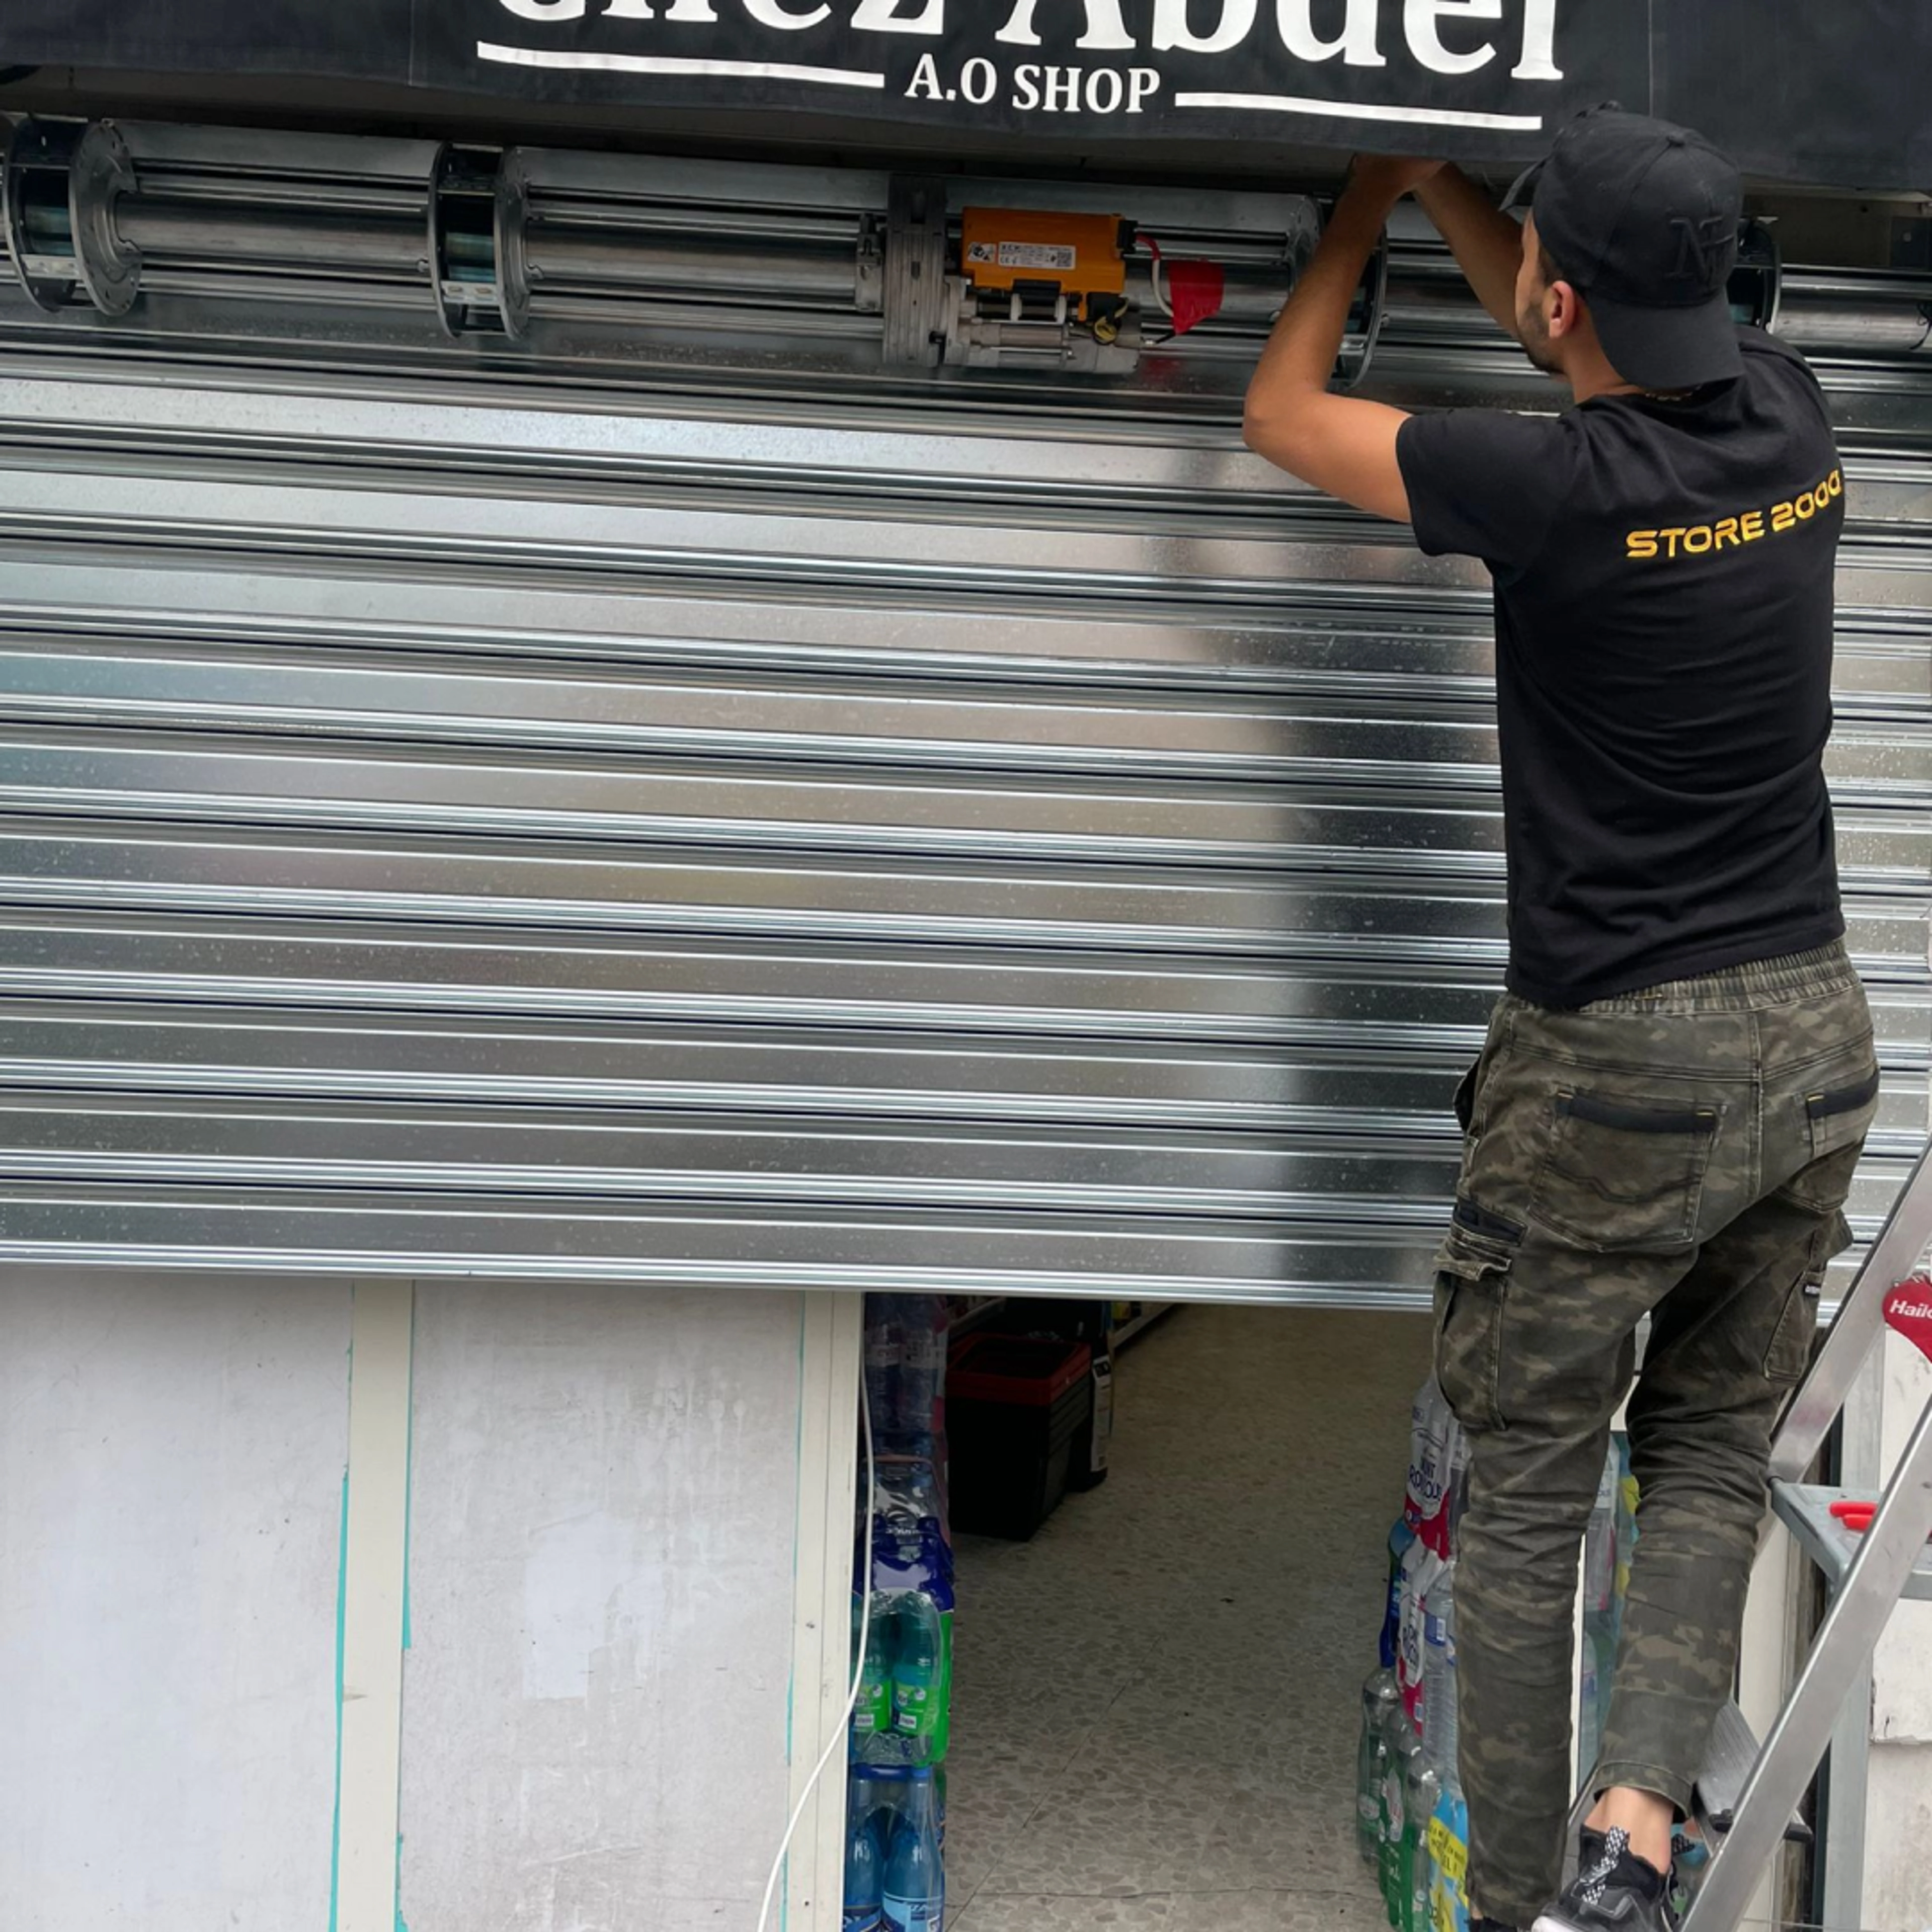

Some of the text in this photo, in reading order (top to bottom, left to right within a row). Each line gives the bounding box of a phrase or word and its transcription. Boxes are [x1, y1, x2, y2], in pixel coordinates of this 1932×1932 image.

[904, 54, 1160, 114] A.O SHOP
[1626, 469, 1842, 558] STORE 2000
